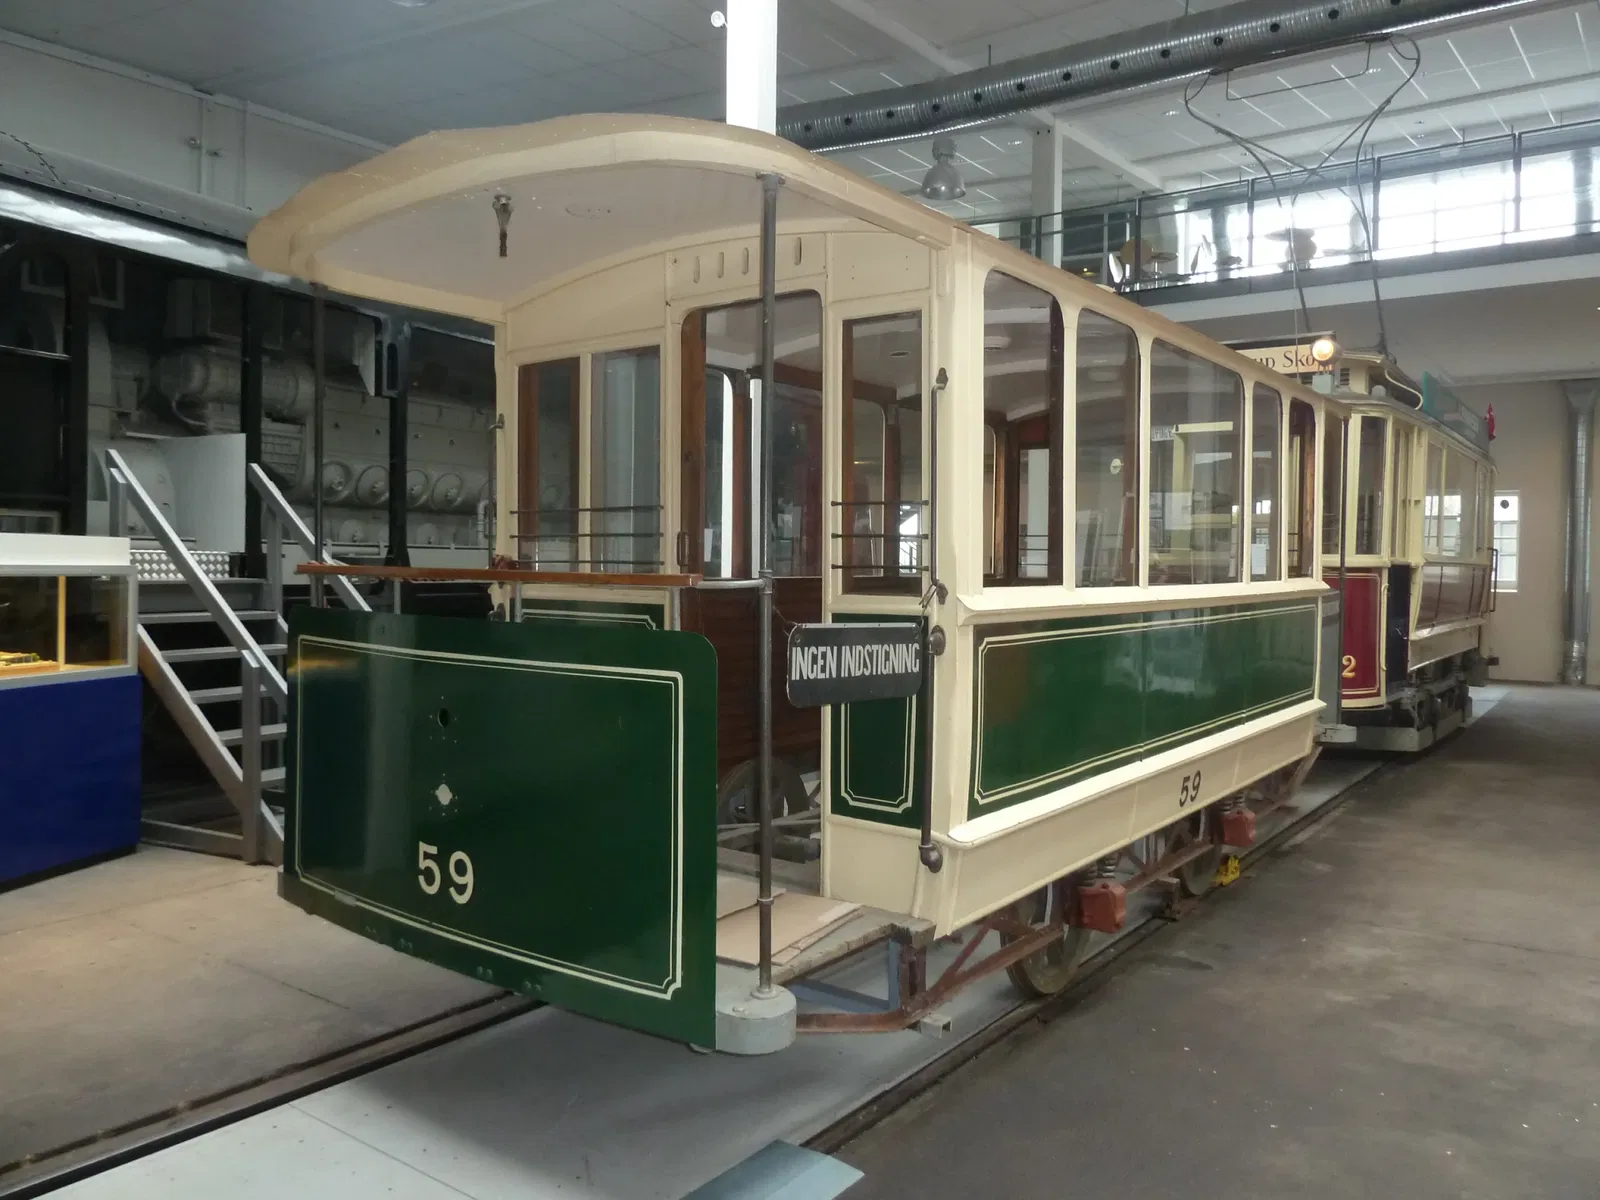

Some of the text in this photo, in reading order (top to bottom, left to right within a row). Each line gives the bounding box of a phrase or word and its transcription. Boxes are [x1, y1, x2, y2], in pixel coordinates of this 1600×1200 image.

[1282, 350, 1316, 368] Sko
[791, 643, 920, 680] INGEN INDSTIGNING
[1179, 769, 1202, 808] 59
[417, 840, 475, 905] 59
